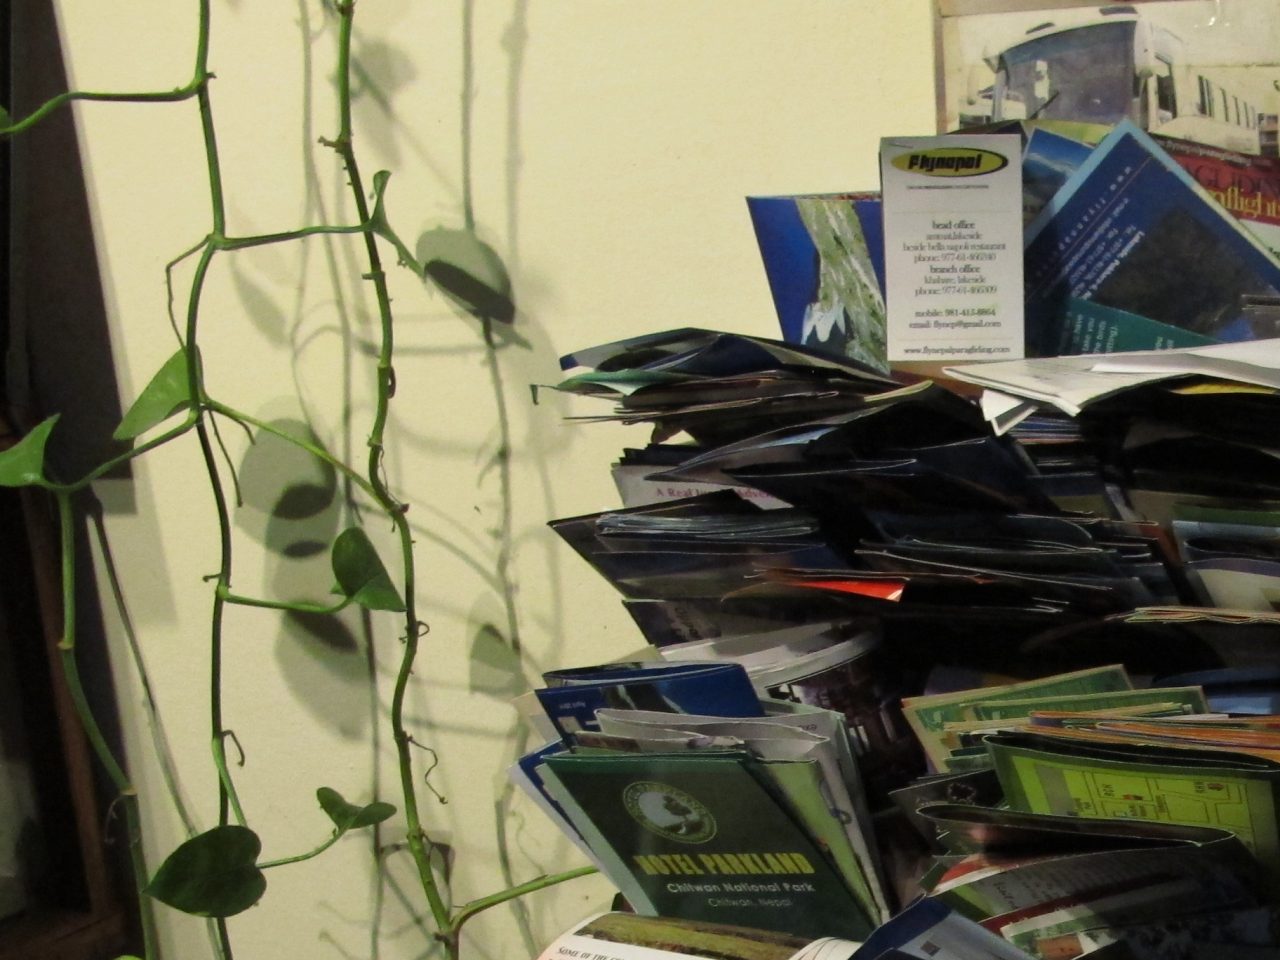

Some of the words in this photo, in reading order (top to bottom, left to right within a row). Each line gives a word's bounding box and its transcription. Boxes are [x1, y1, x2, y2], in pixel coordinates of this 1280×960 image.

[954, 220, 975, 229] office
[959, 264, 980, 273] office
[633, 853, 705, 875] HOTEL
[698, 852, 816, 875] PARKLAND
[667, 882, 721, 894] Chitwan
[724, 882, 780, 893] National
[558, 947, 579, 959] SOME
